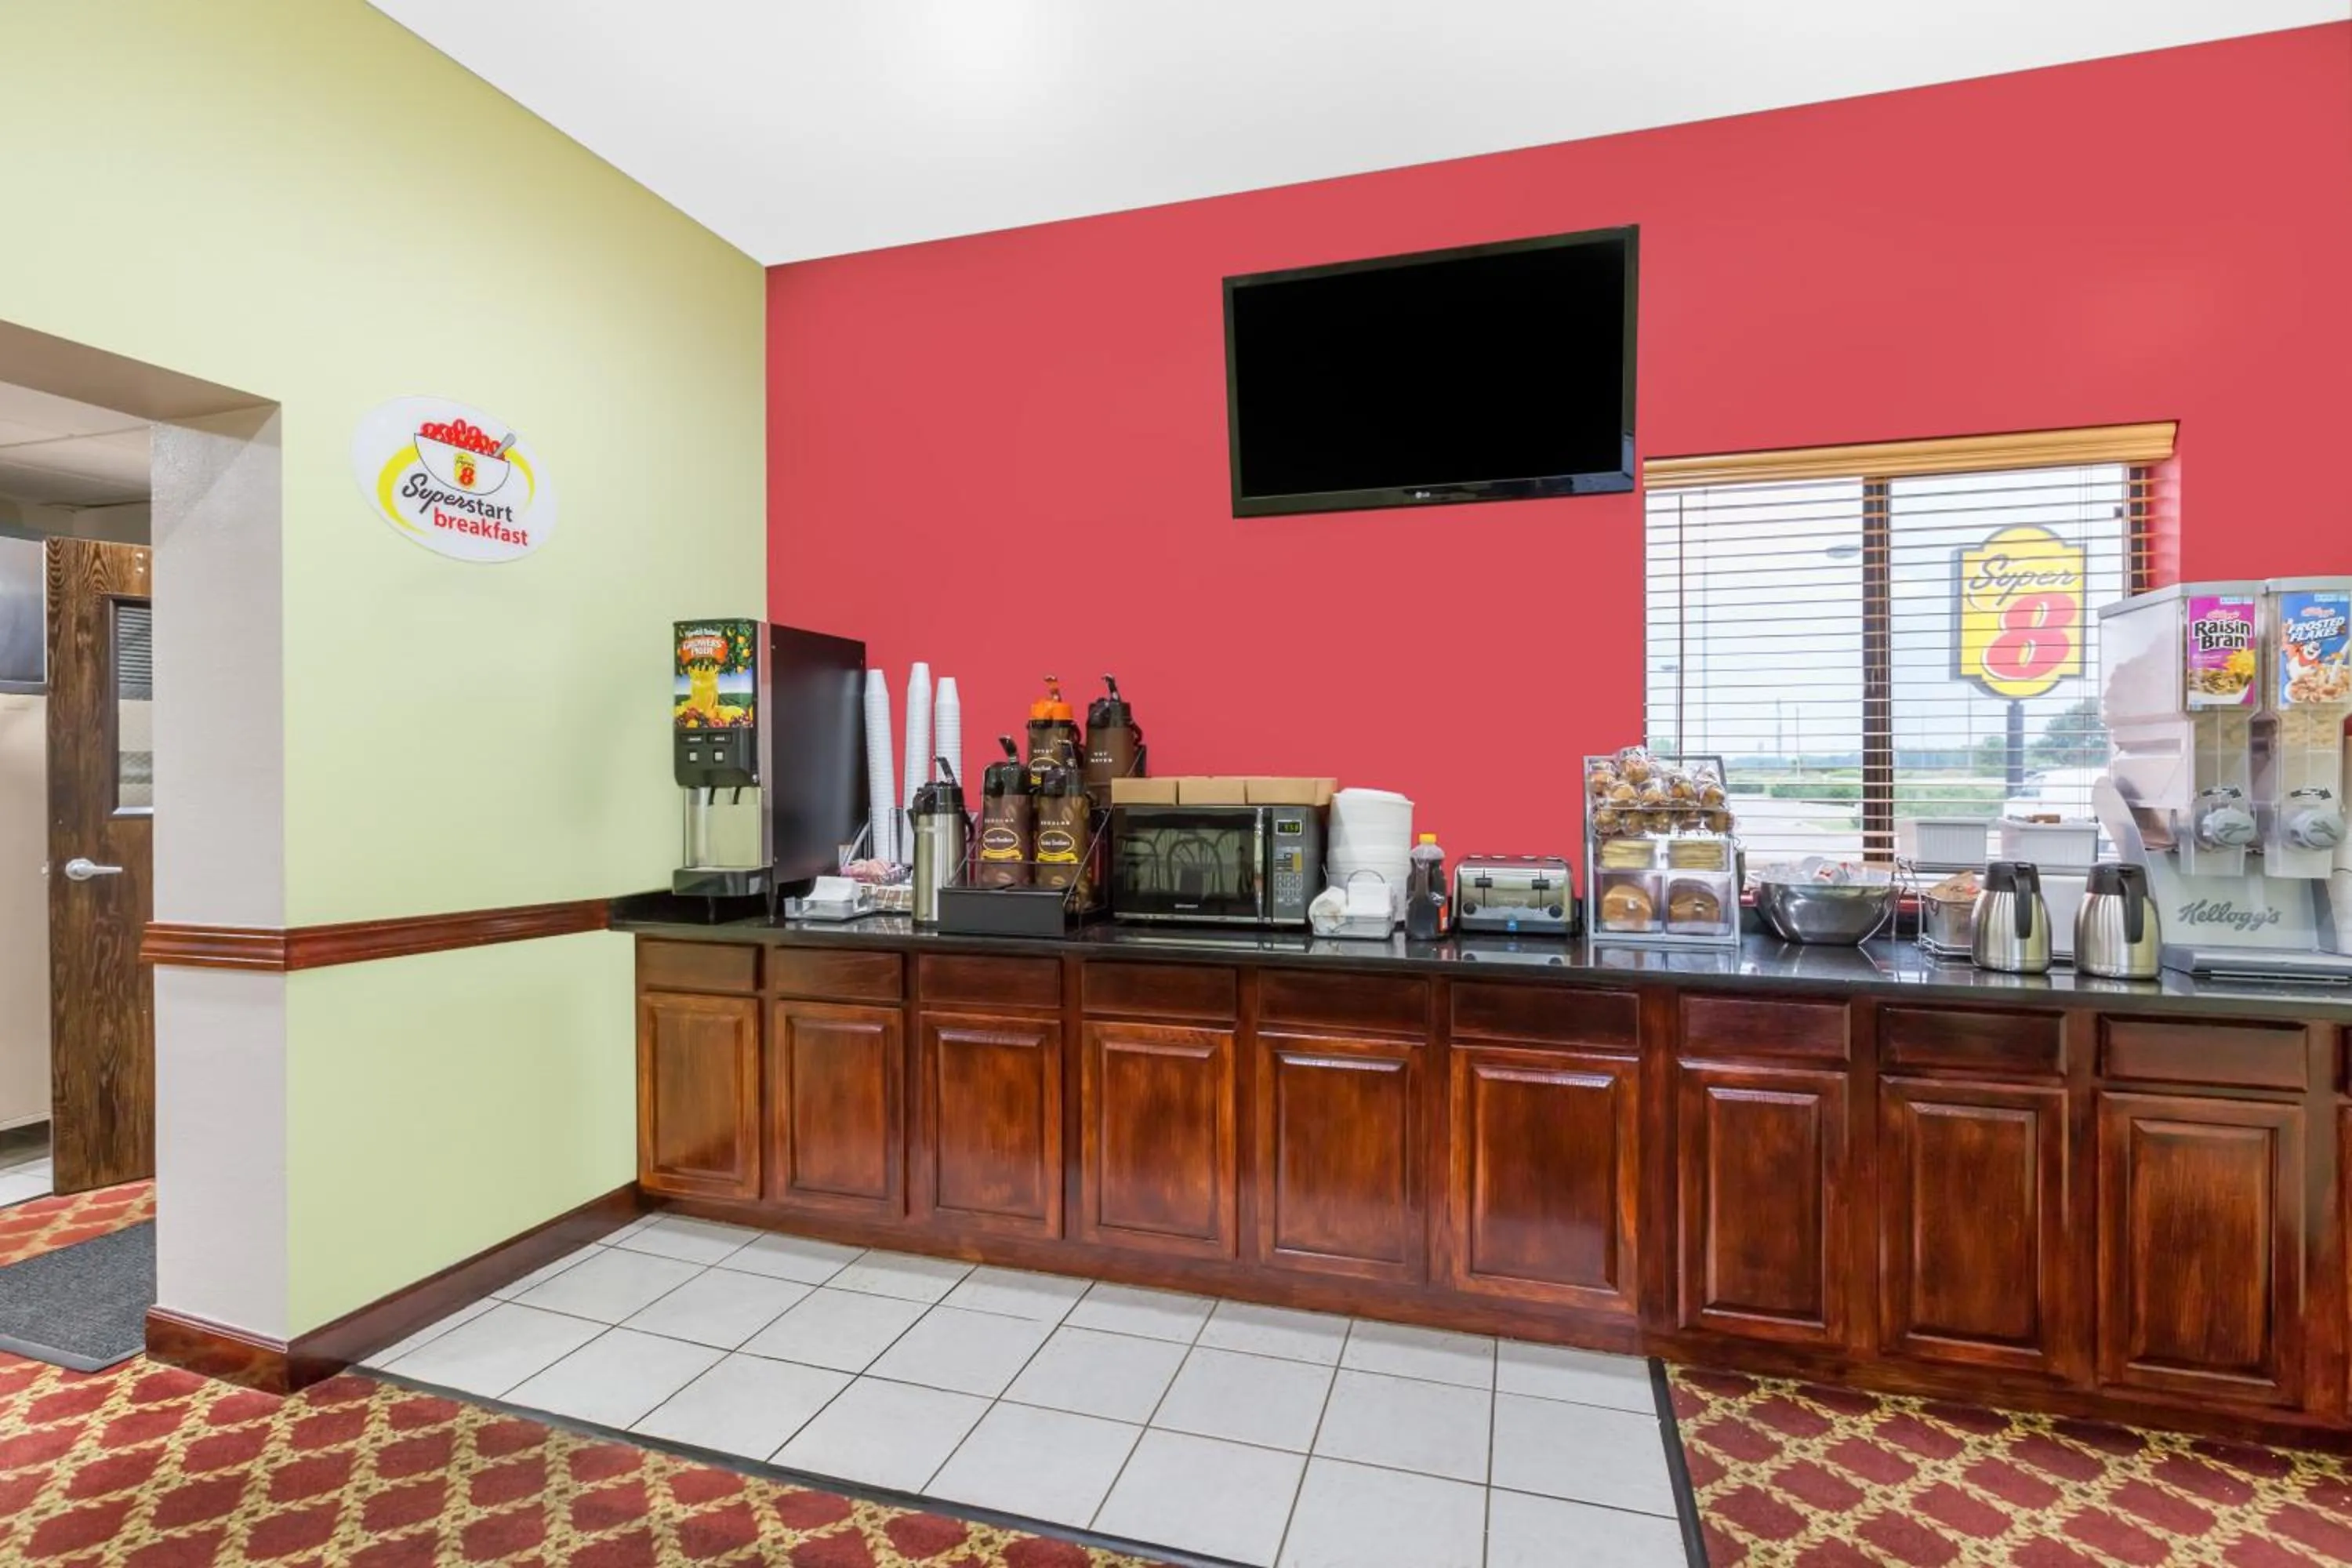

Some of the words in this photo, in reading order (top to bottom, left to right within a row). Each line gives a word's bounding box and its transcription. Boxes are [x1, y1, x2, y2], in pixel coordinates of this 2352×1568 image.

[459, 466, 475, 486] 8
[402, 473, 513, 521] Superstart
[434, 507, 528, 546] breakfast
[1968, 554, 2078, 607] Super
[1981, 592, 2078, 681] 8
[2194, 620, 2250, 636] Raisin
[2201, 636, 2245, 649] Bran
[2177, 899, 2282, 931] Kellogg's
